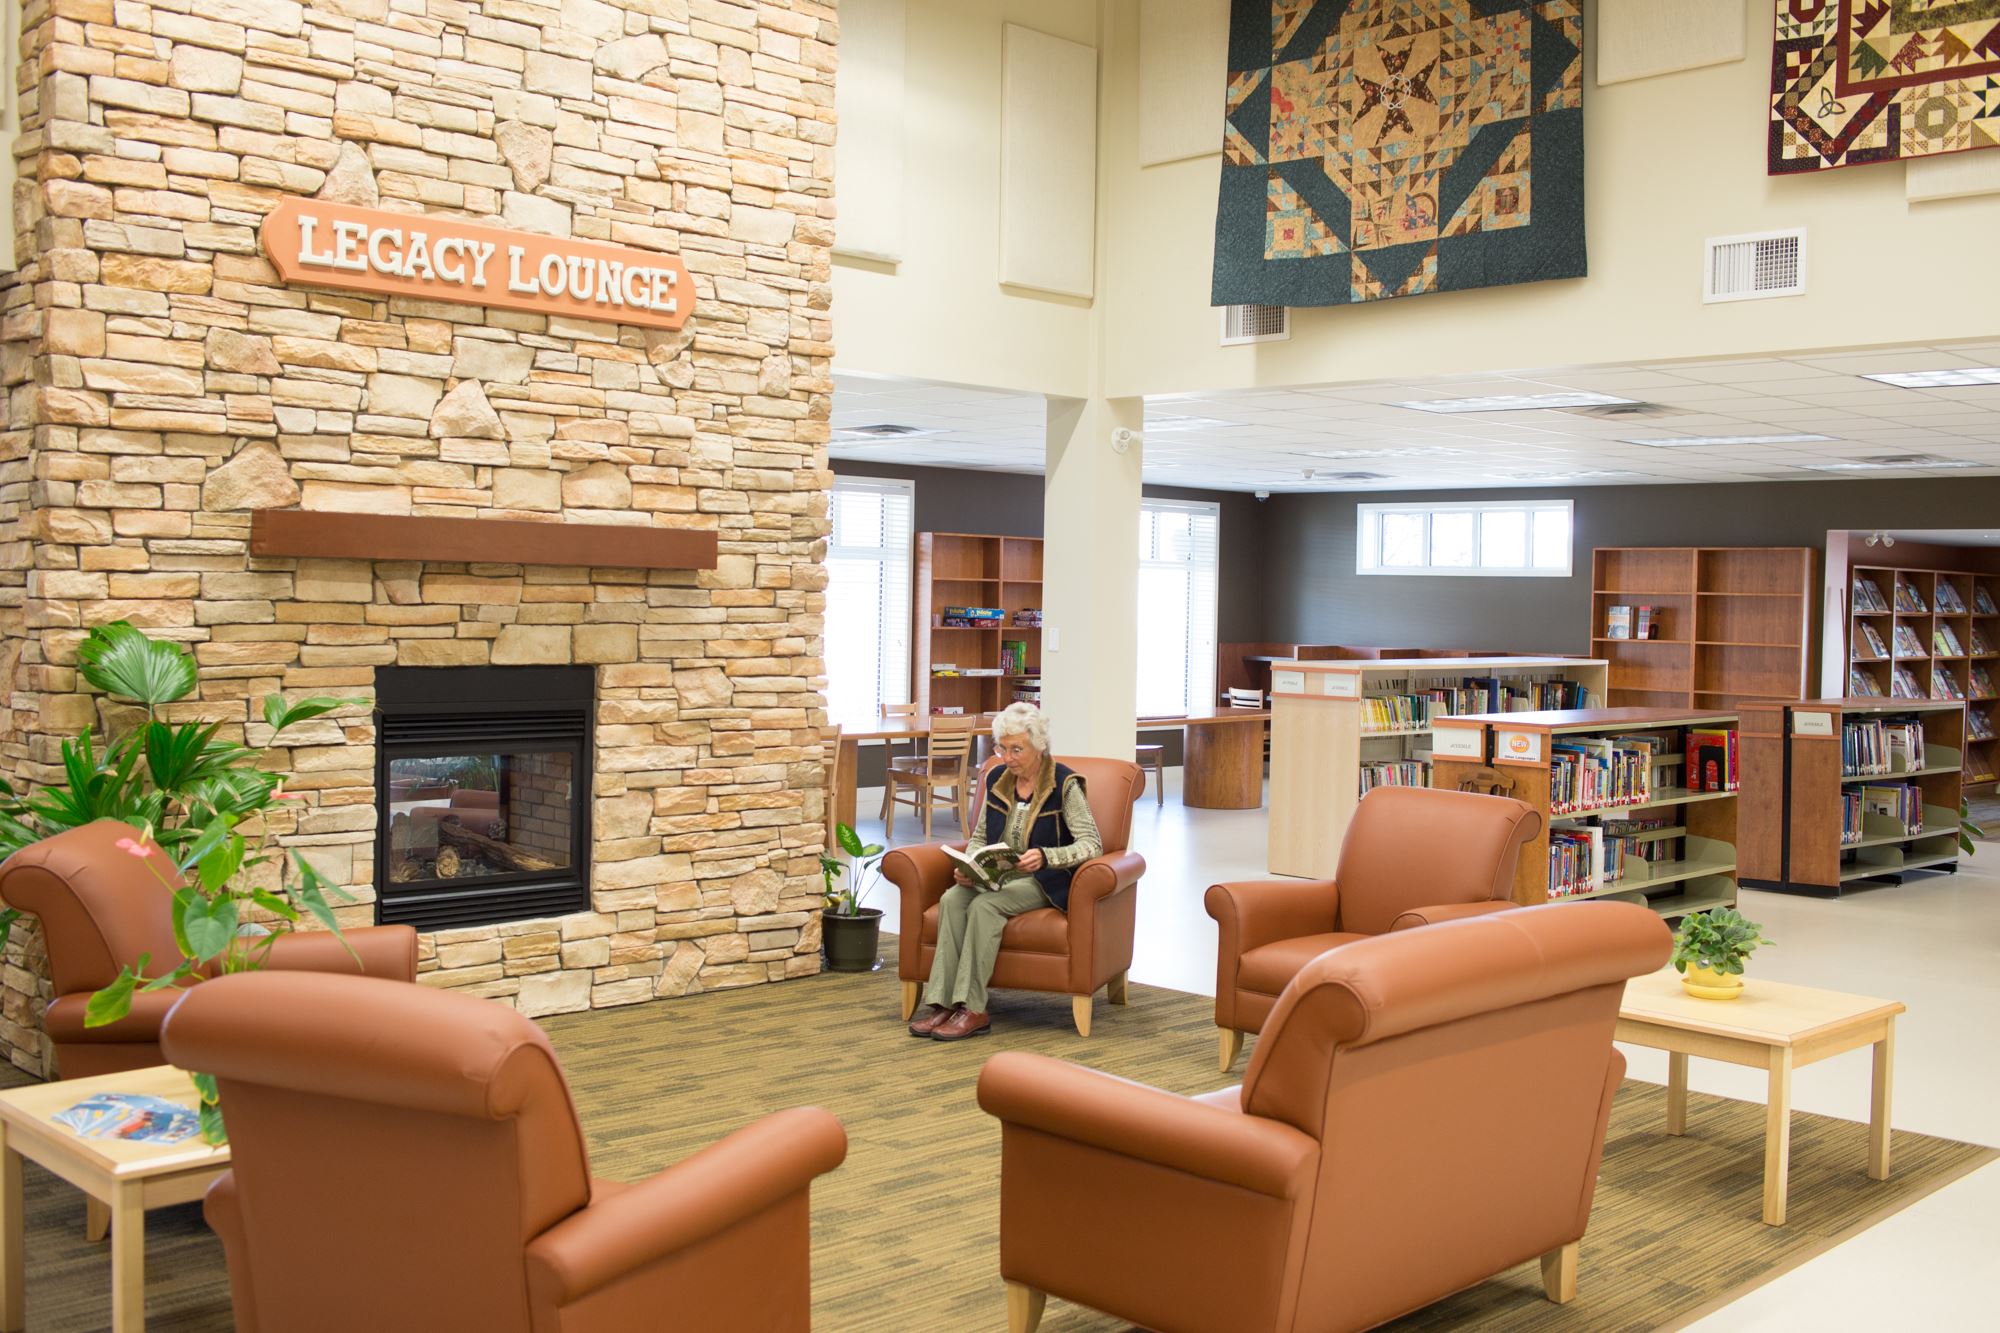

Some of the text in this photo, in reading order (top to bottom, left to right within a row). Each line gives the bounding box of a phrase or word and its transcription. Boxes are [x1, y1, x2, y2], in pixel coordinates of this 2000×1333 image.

[298, 214, 678, 313] LEGACY LOUNGE
[1511, 739, 1527, 748] NEW
